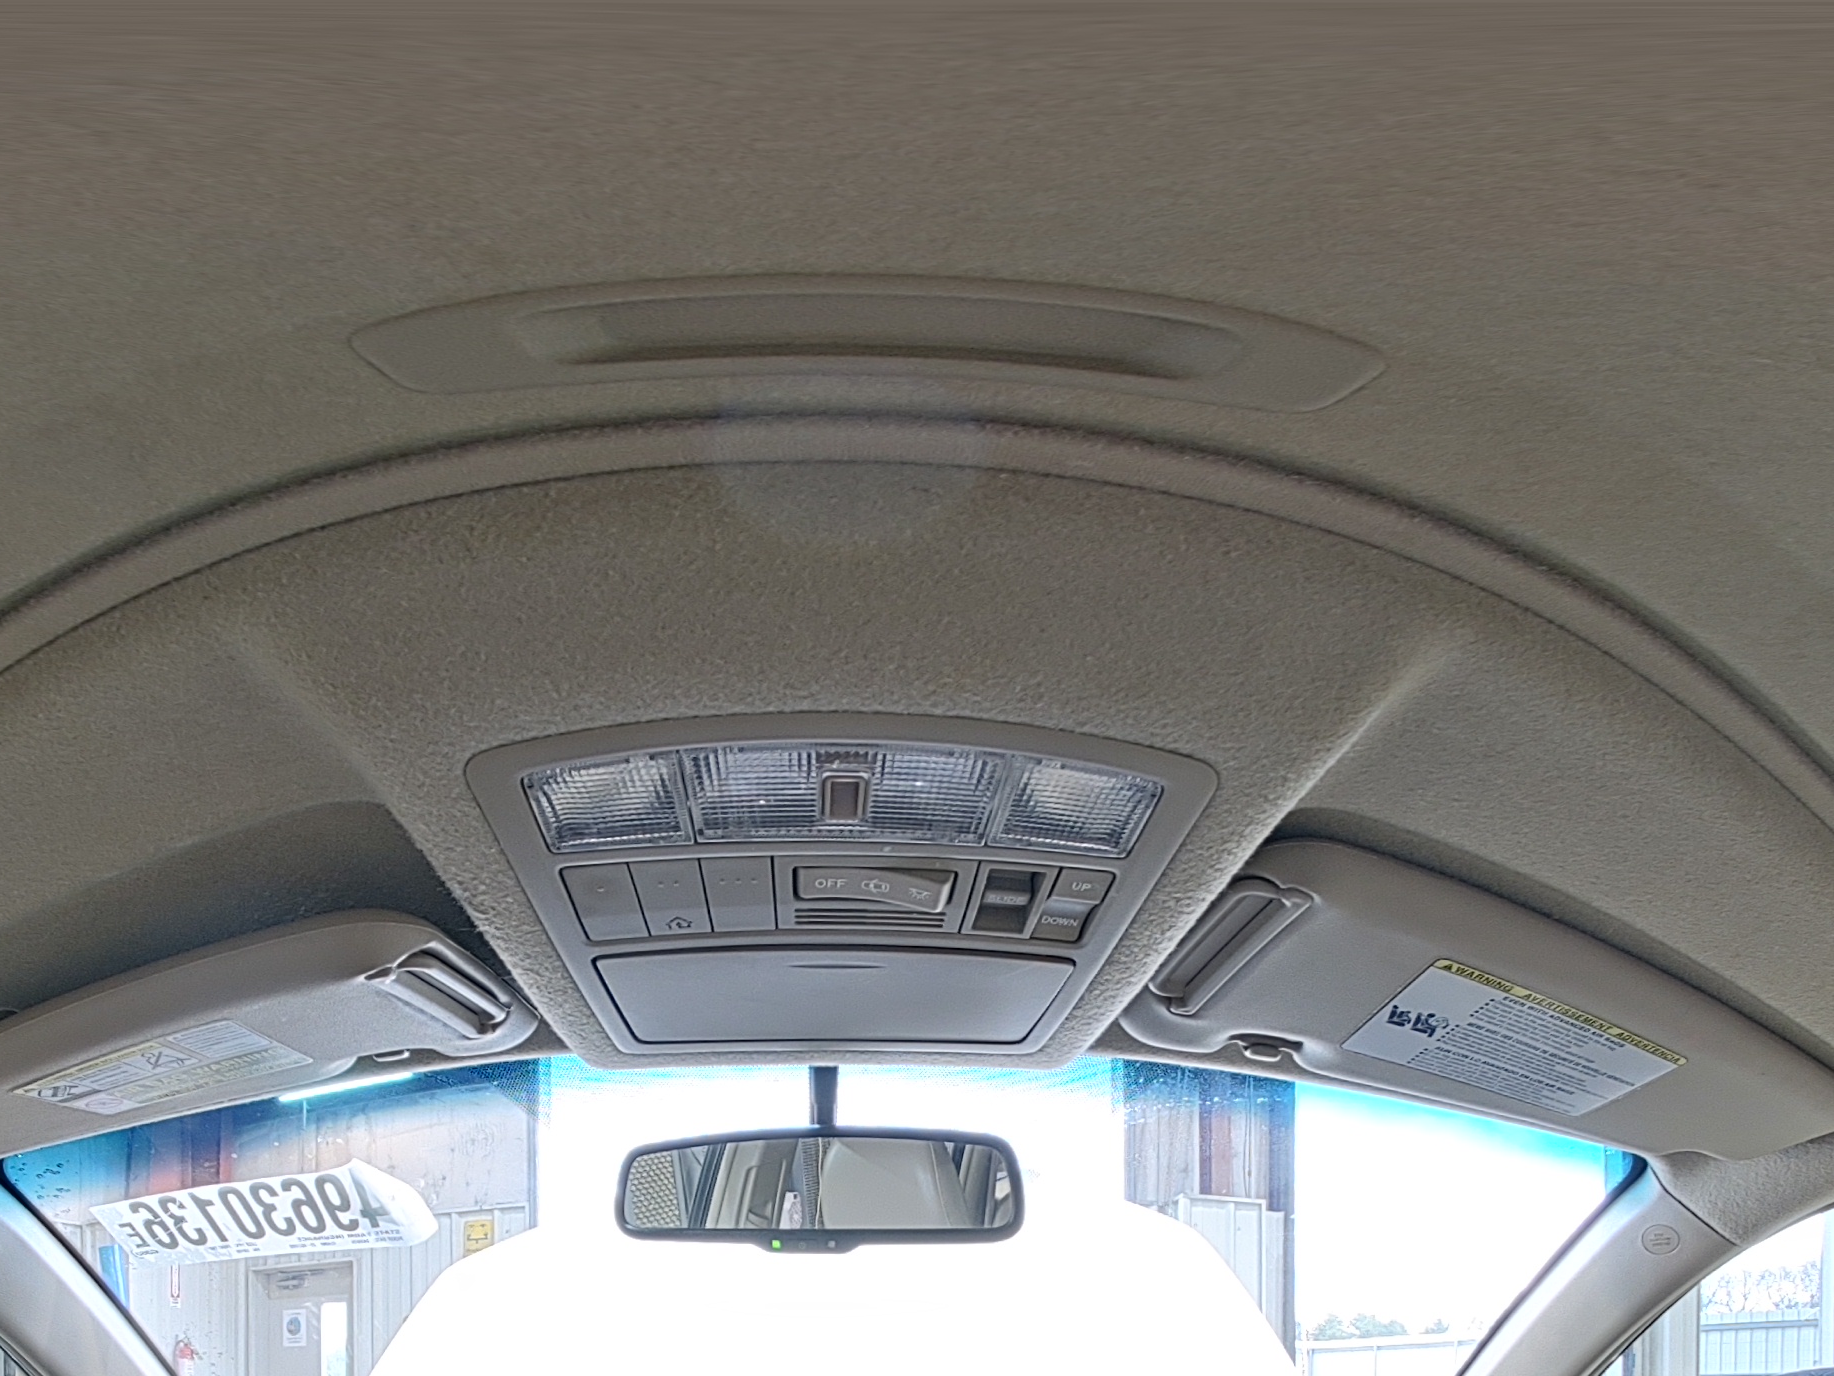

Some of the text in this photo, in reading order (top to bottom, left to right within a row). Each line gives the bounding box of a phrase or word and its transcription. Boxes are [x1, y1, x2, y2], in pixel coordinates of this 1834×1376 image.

[814, 878, 847, 889] OFF
[1070, 881, 1092, 892] UP
[1041, 914, 1079, 928] DOWN
[1454, 964, 1514, 993] WARNING
[1522, 992, 1615, 1032] AVERTISSEMENT
[1613, 1030, 1681, 1065] ADVERTENCIA
